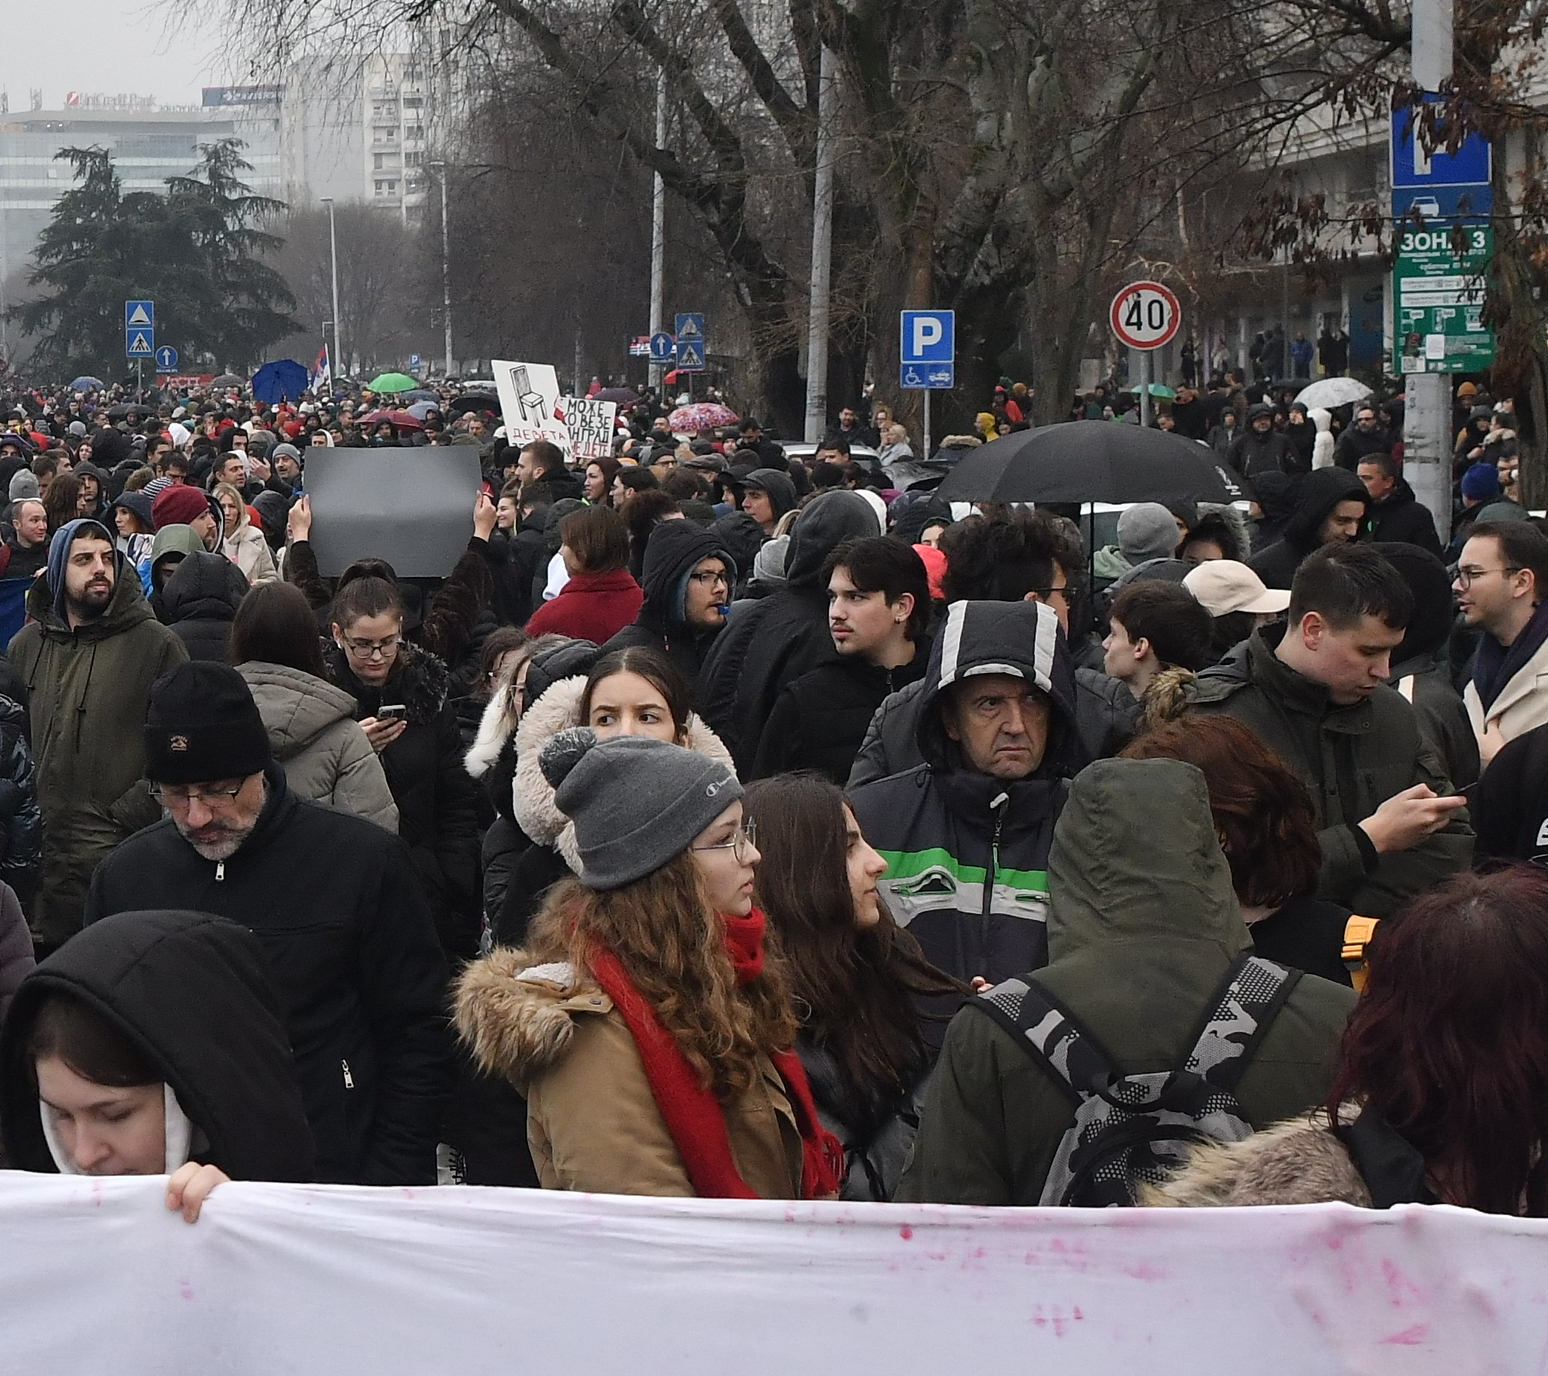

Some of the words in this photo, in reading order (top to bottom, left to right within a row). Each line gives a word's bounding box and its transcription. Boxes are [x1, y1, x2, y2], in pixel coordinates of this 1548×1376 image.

[1400, 232, 1454, 251] ЗОН
[1471, 231, 1486, 249] 3
[1125, 299, 1164, 331] 40
[913, 317, 942, 356] P
[567, 399, 605, 416] МОЖЕ
[566, 412, 577, 426] О
[580, 413, 611, 430] ВЕЗЕ
[512, 427, 566, 441] ДЕВЕТА
